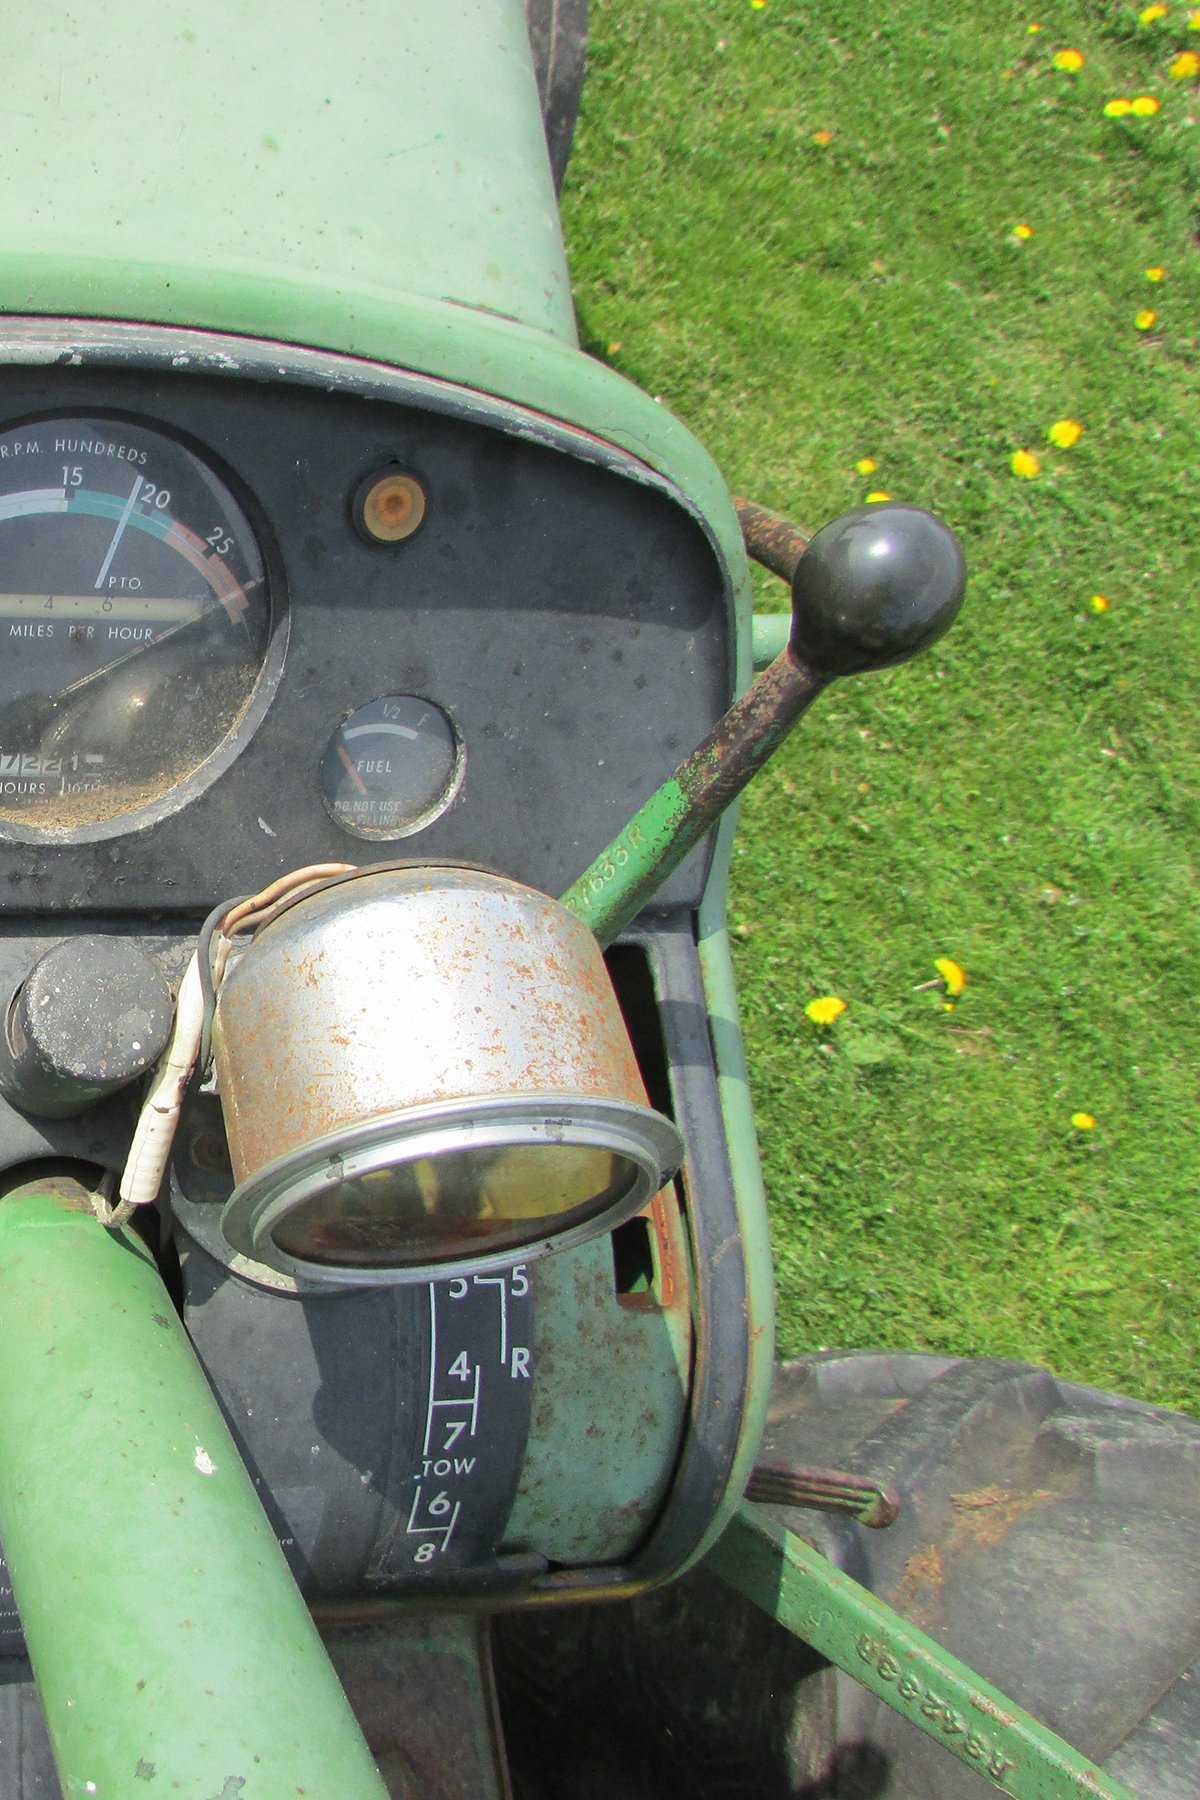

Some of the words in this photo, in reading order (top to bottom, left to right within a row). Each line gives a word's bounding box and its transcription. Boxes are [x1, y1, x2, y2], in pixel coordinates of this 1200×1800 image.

[0, 441, 43, 458] R.P.M.
[55, 439, 148, 465] HUNDREDS
[62, 466, 83, 486] 15
[140, 483, 171, 509] 20
[205, 526, 234, 554] 25
[43, 596, 54, 611] 4
[101, 597, 113, 612] 6
[9, 624, 54, 638] MILES
[68, 625, 95, 639] PER
[108, 627, 153, 640] HOUR
[356, 760, 392, 773] FUEL
[511, 1265, 529, 1296] 5
[448, 1351, 471, 1381] 4
[511, 1347, 530, 1378] R
[443, 1421, 467, 1450] 7
[422, 1457, 476, 1477] TOW
[428, 1491, 450, 1515] 6
[413, 1543, 436, 1562] 8
